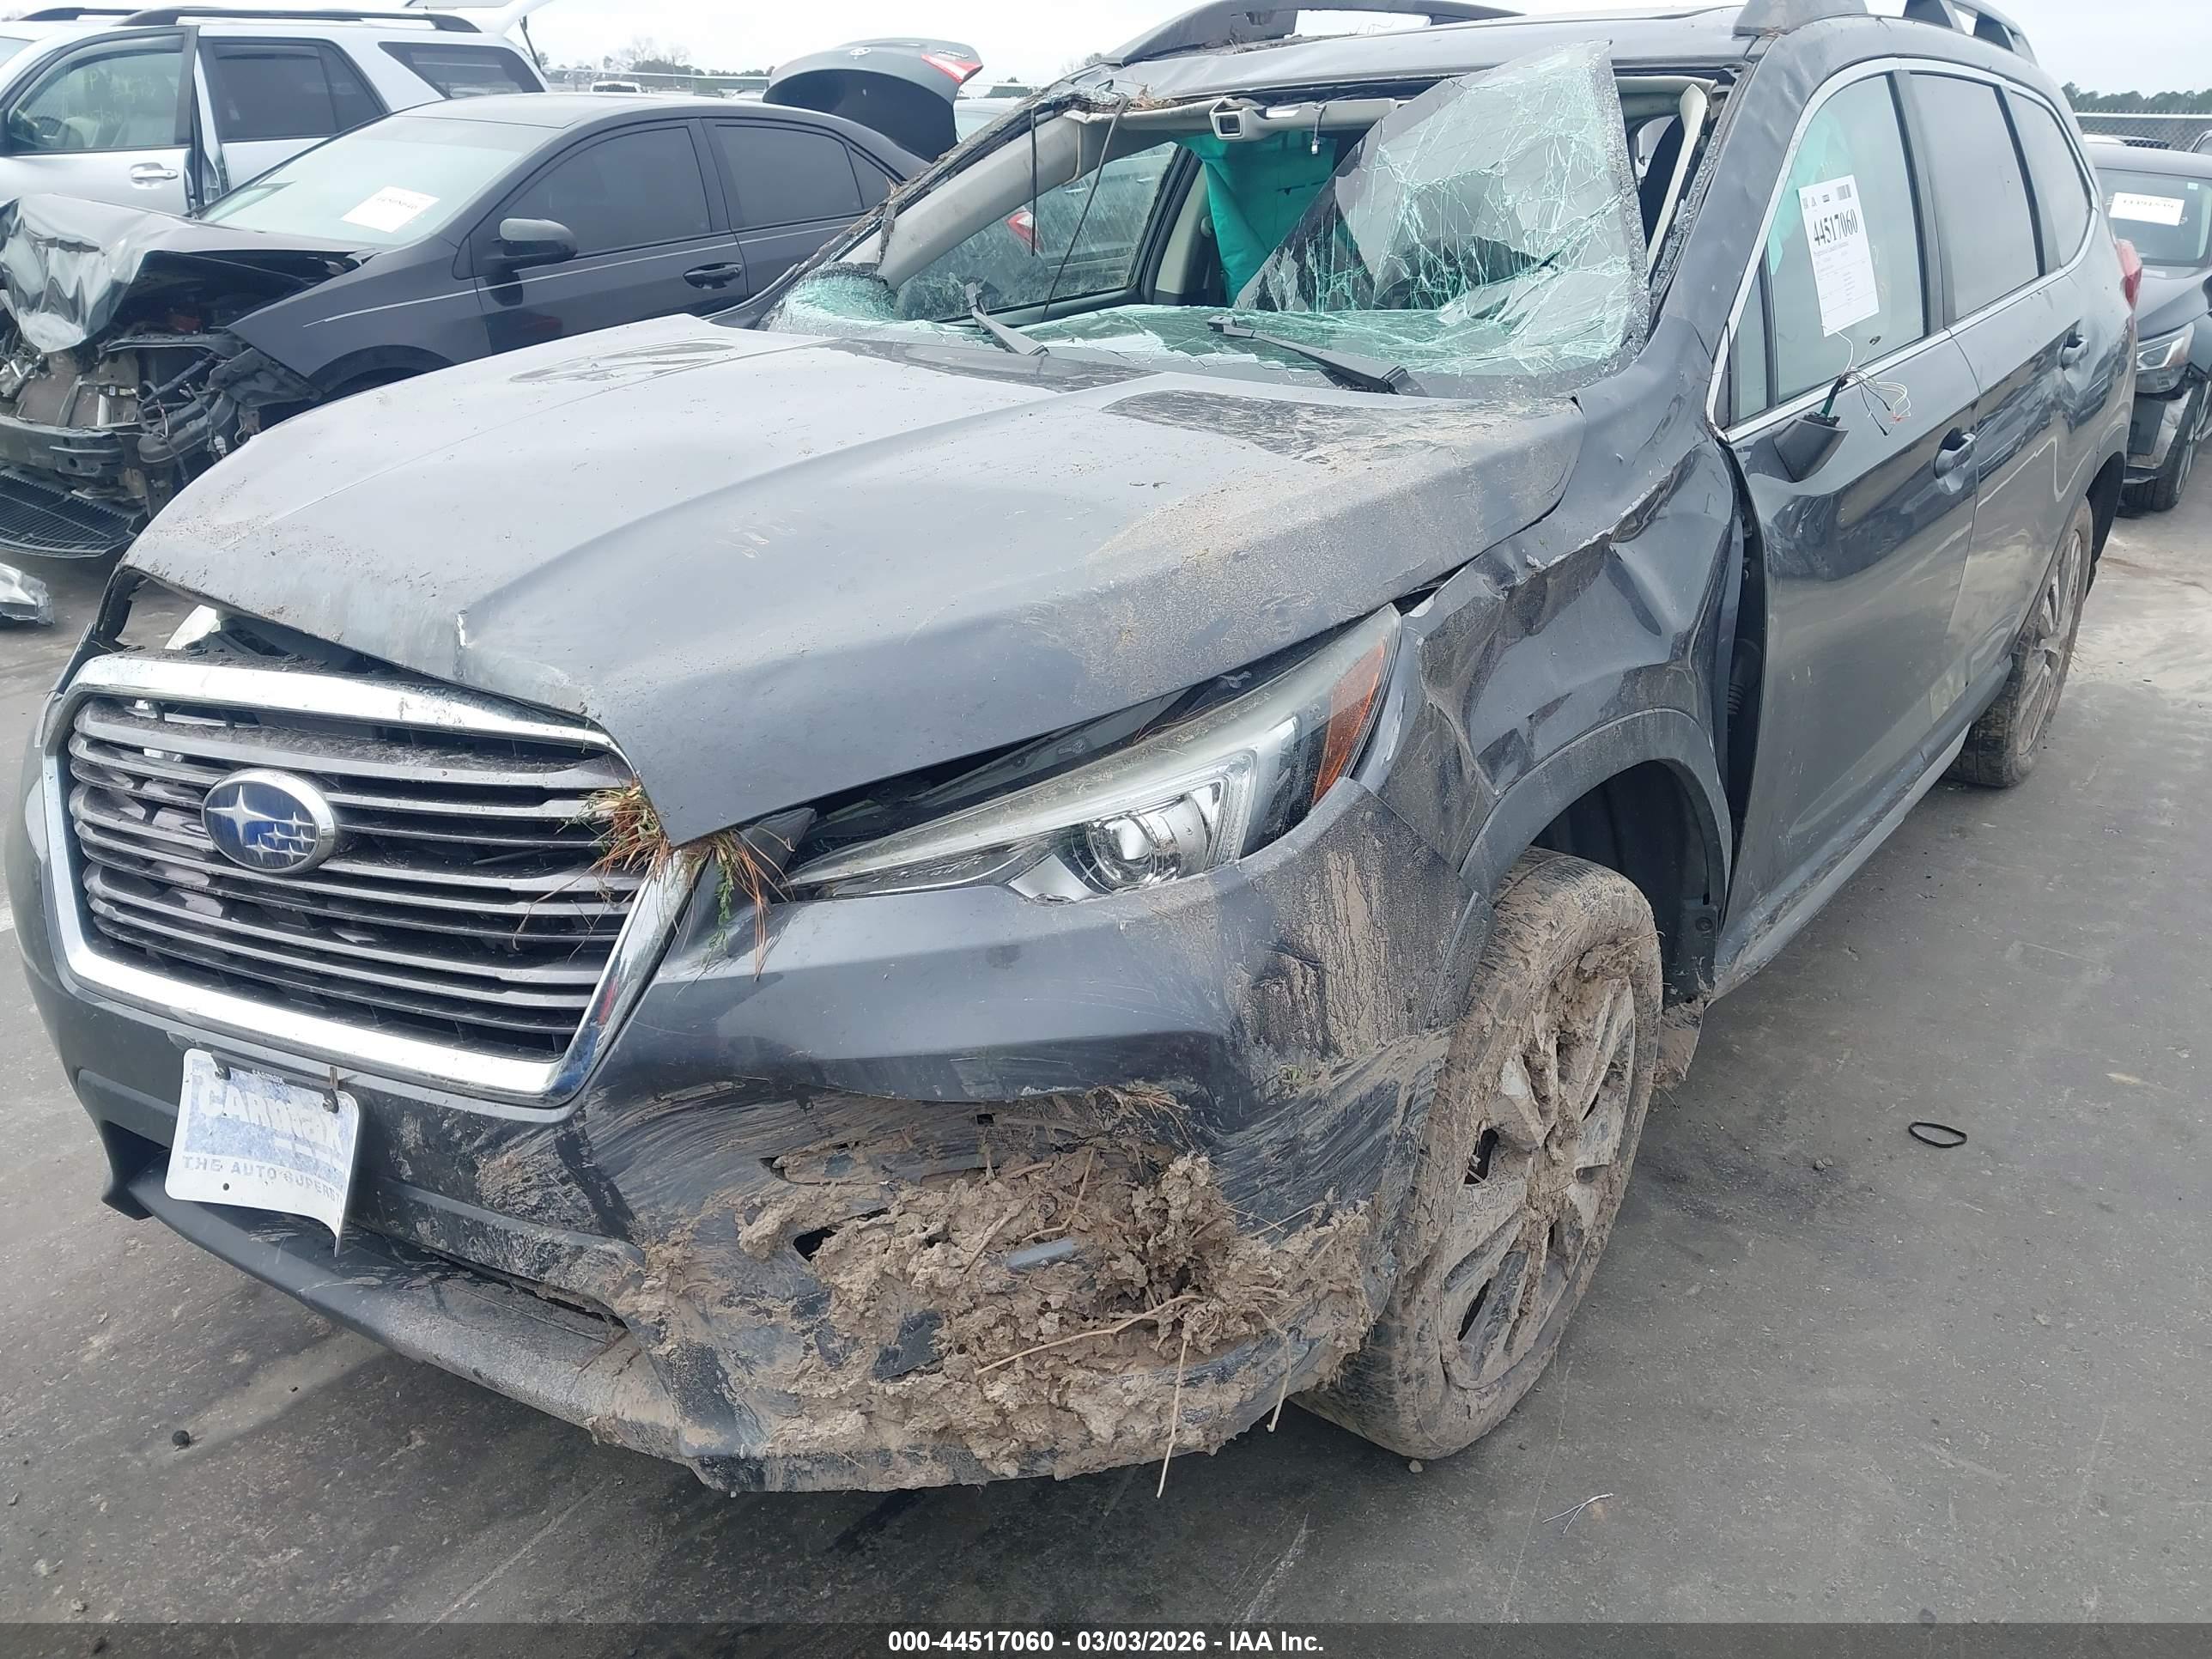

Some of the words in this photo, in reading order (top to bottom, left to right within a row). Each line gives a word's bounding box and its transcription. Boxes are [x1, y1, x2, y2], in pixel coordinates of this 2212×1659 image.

[1813, 208, 1859, 247] 44517060
[183, 1156, 222, 1173] THE
[231, 1161, 277, 1181] AUTO
